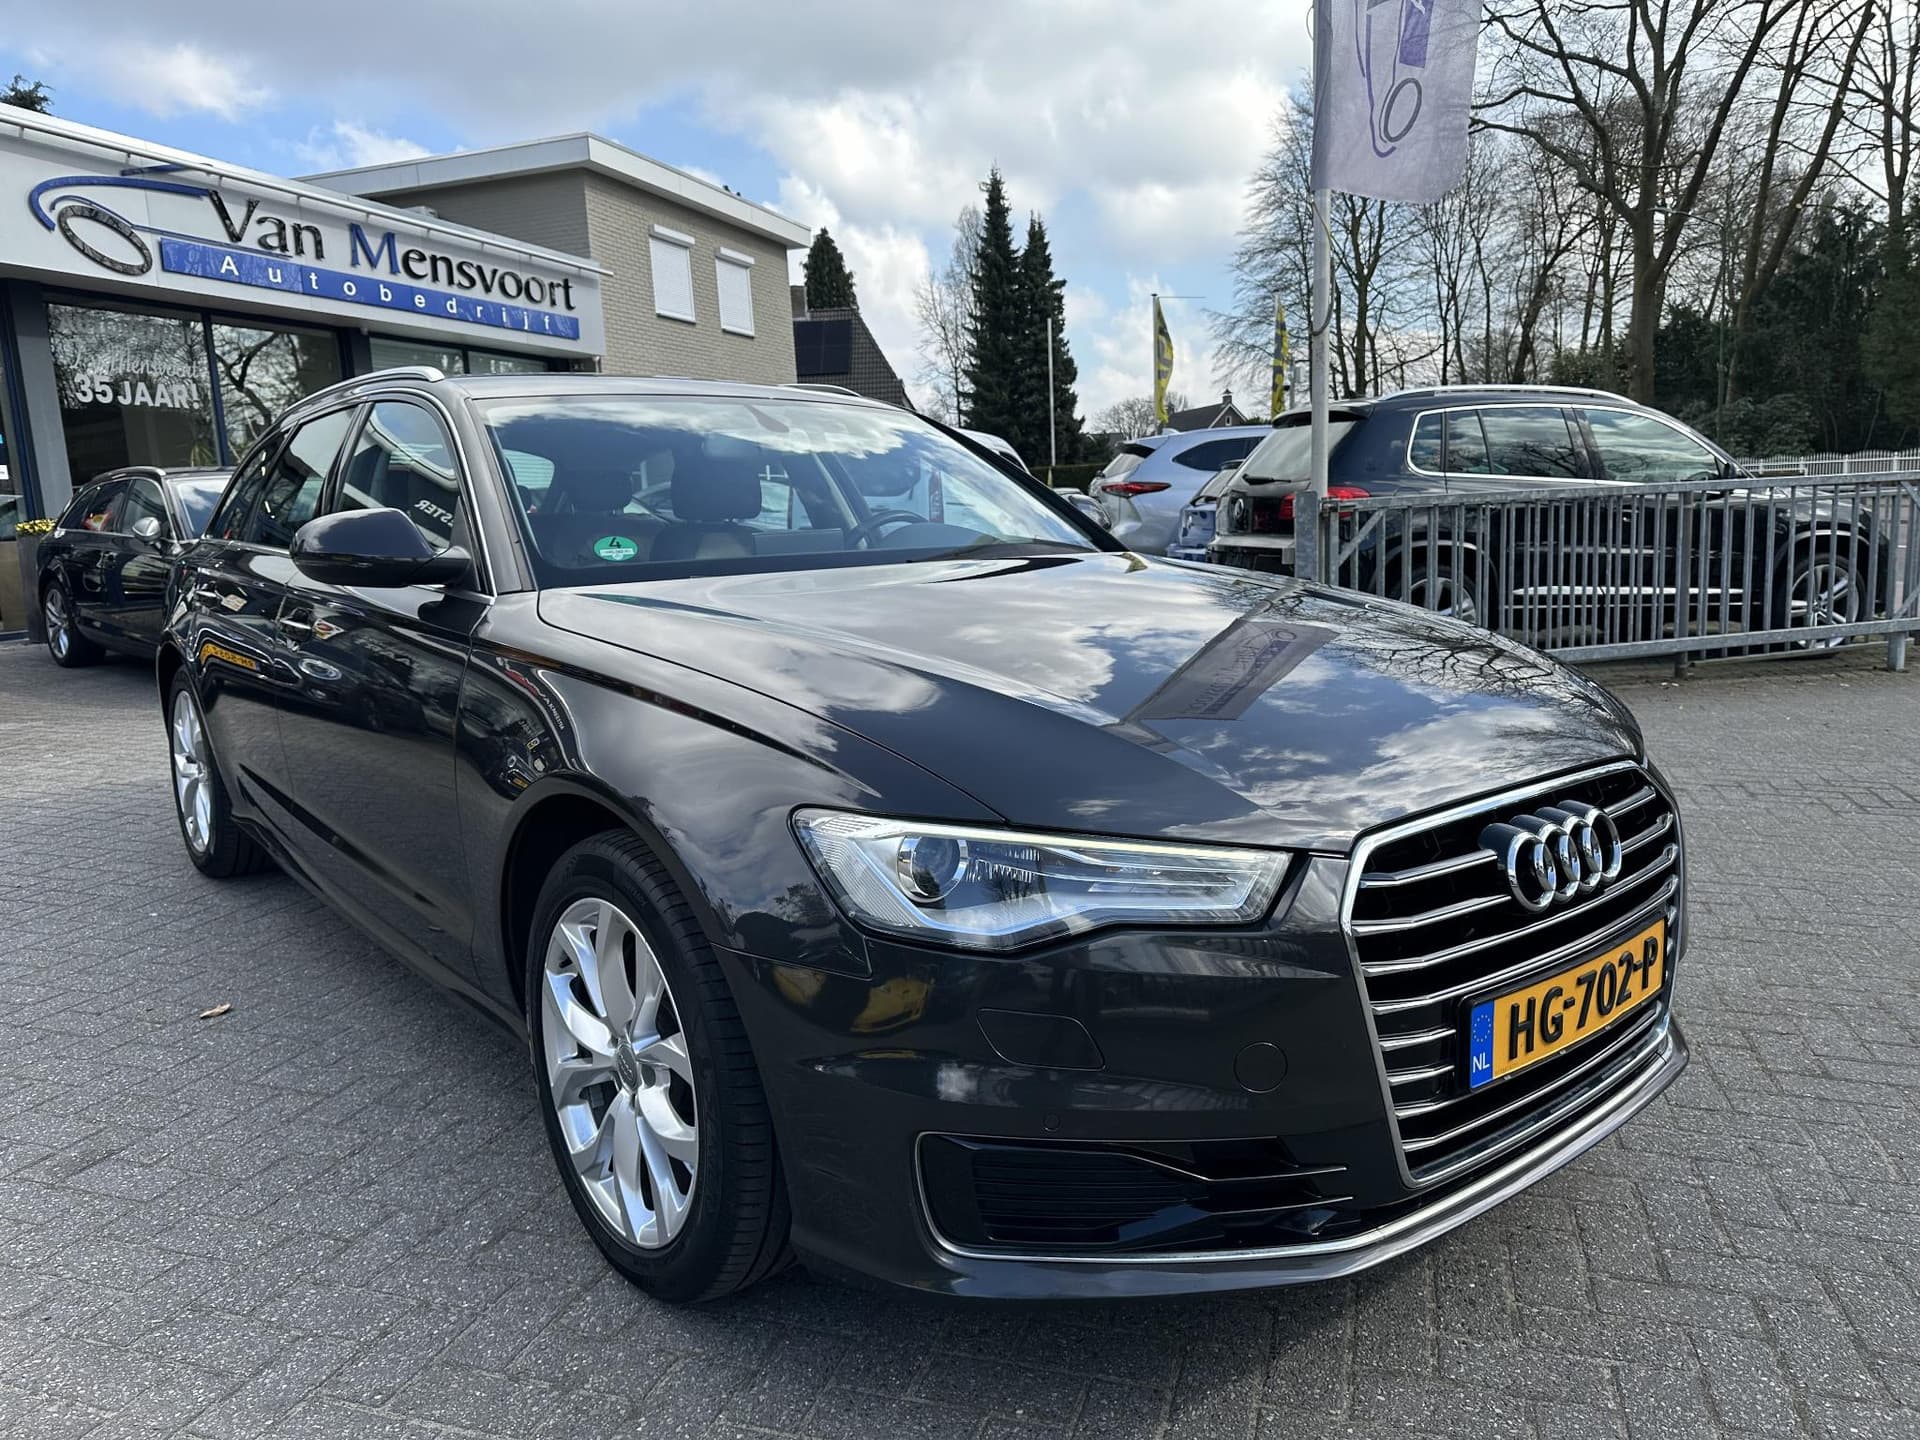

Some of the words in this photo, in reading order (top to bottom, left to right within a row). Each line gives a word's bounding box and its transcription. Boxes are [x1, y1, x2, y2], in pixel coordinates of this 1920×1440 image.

[208, 189, 325, 261] Van
[348, 222, 576, 311] Mensvoort
[220, 255, 550, 330] Autobedrijf
[74, 372, 114, 404] 35
[117, 380, 200, 410] JAAR!
[609, 537, 621, 549] 4
[1507, 935, 1659, 1061] HG-702-P
[1472, 1052, 1490, 1073] NL
